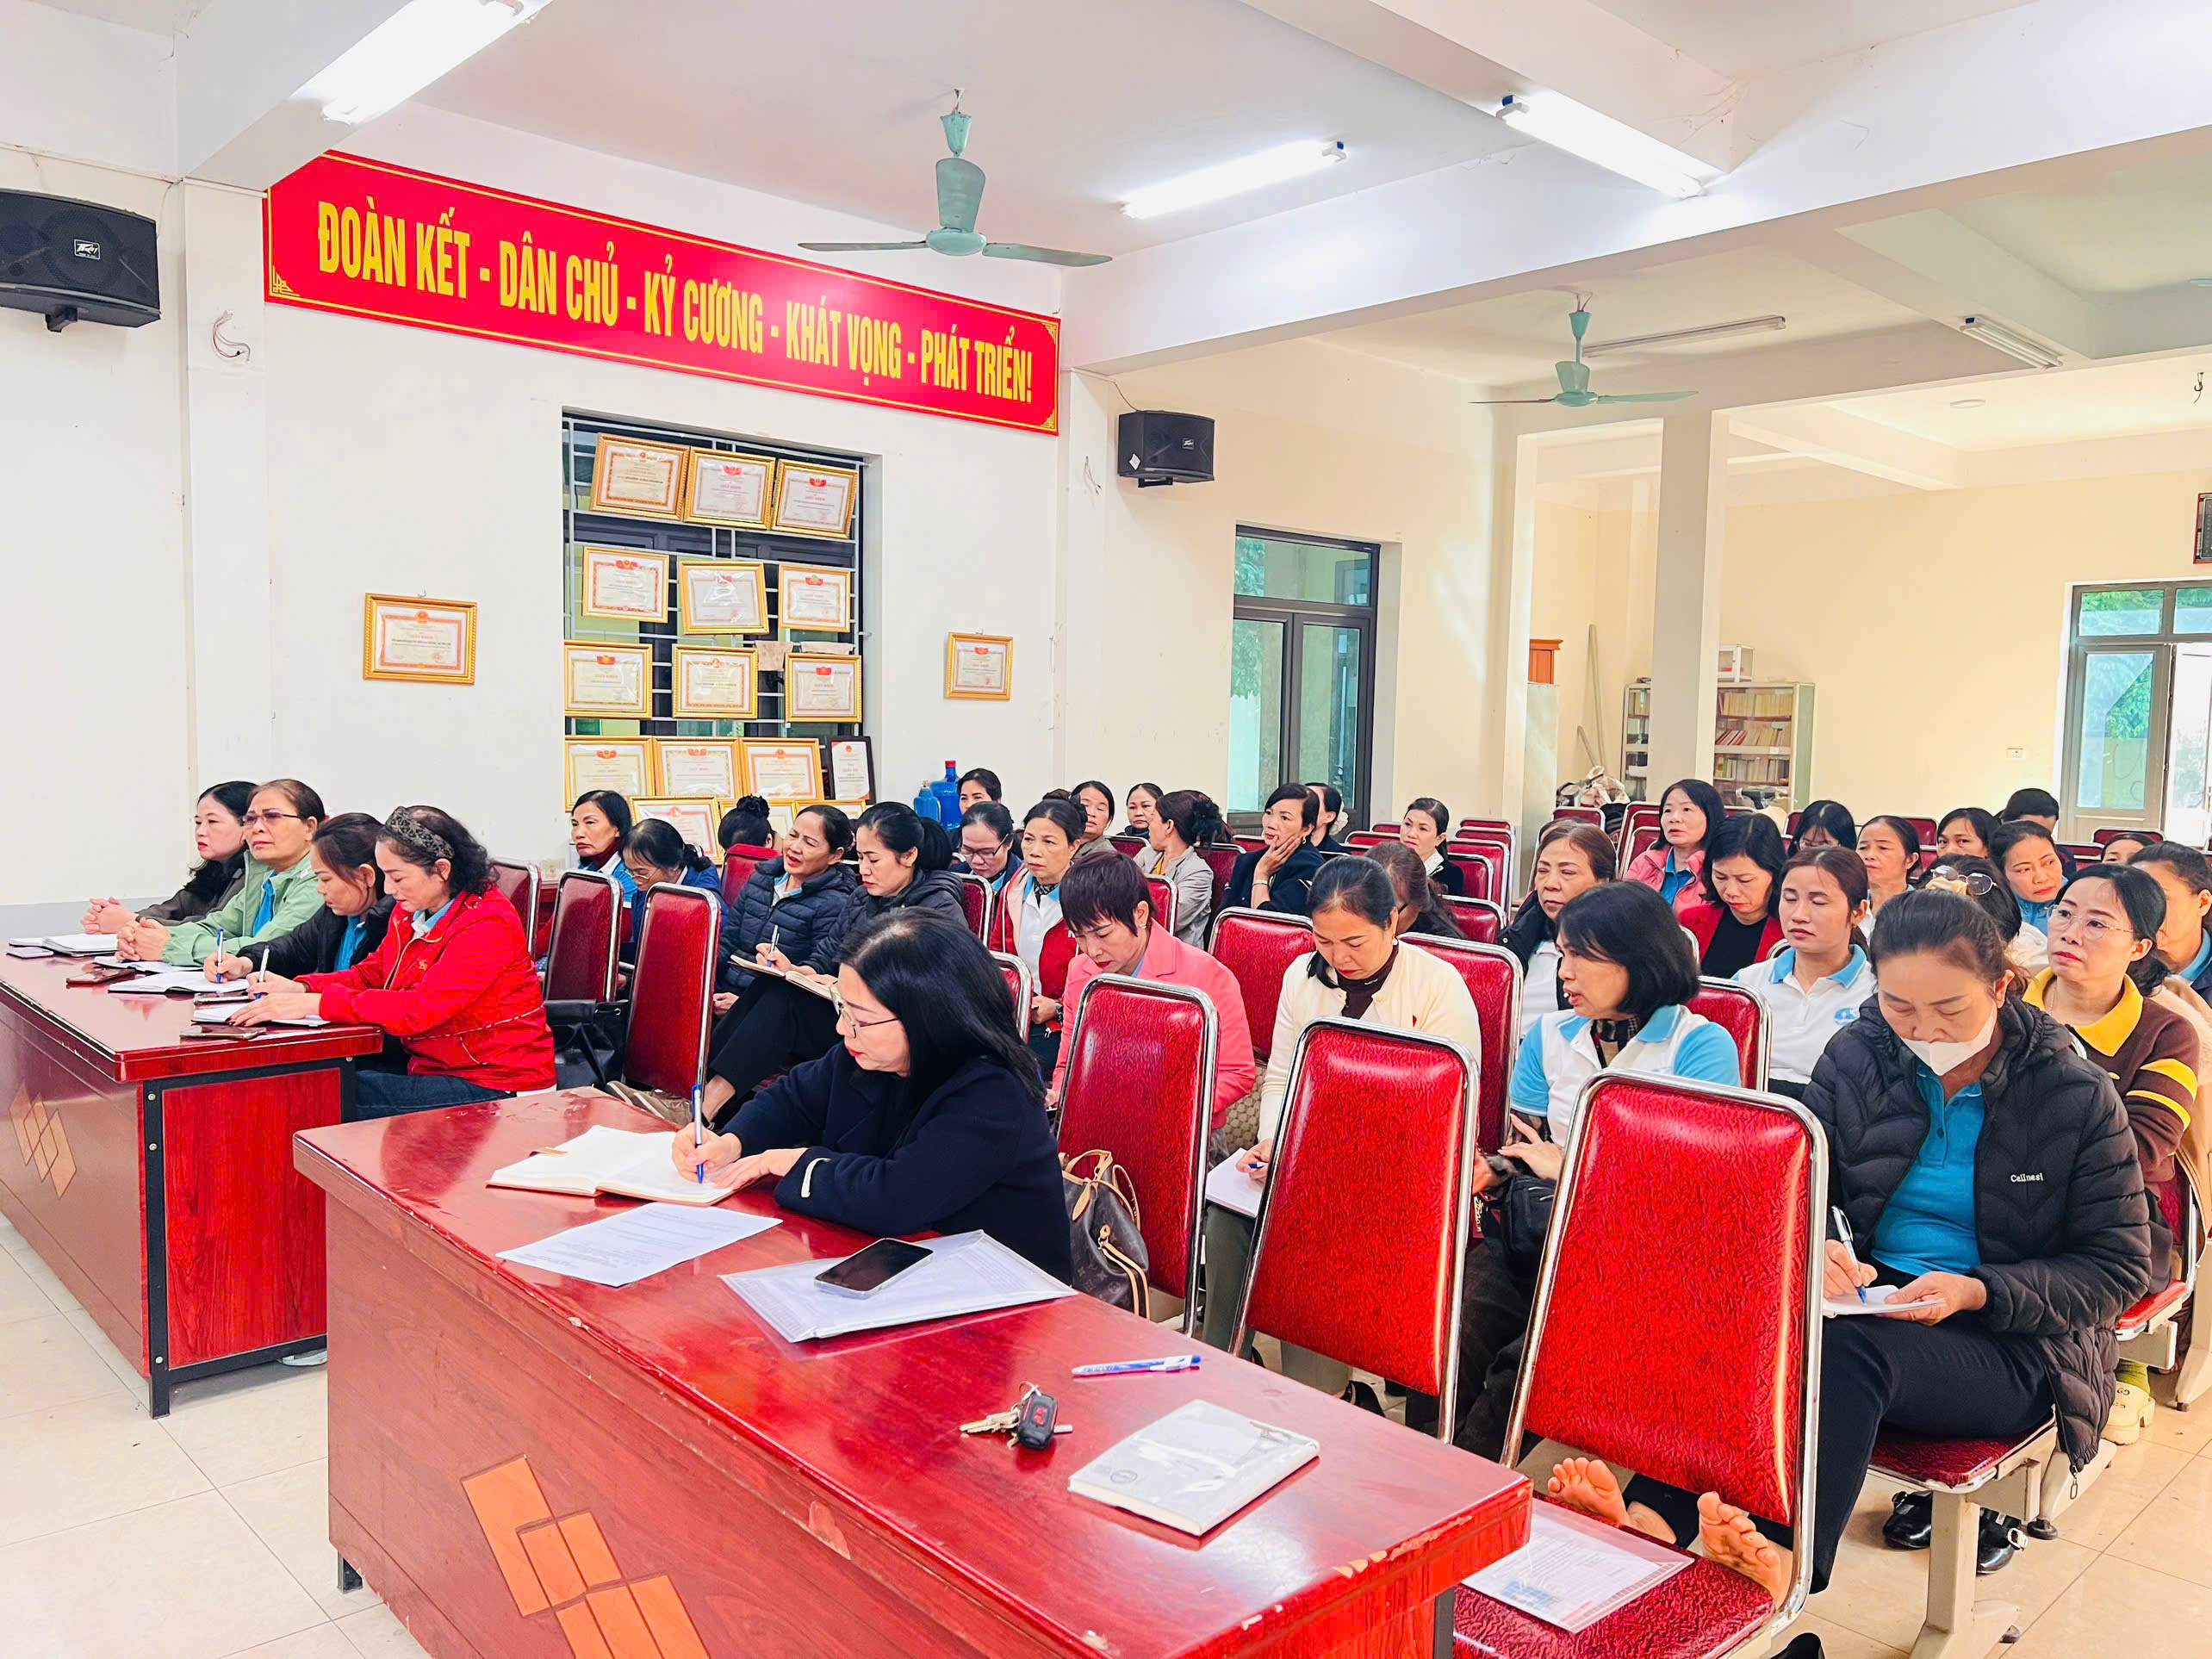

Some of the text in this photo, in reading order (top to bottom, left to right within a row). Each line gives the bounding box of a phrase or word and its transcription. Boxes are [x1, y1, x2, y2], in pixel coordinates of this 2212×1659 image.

[318, 196, 407, 288] ĐOÀN
[416, 207, 471, 299] KẾT
[500, 230, 557, 315] DÂN
[566, 240, 619, 326] CHỦ
[644, 254, 677, 338] KỶ
[683, 278, 764, 354] CƯƠNG
[786, 295, 842, 368] KHÁT
[847, 313, 903, 387] VỌNG
[921, 323, 970, 391] PHÁT
[974, 326, 1033, 404] TRIỂN!
